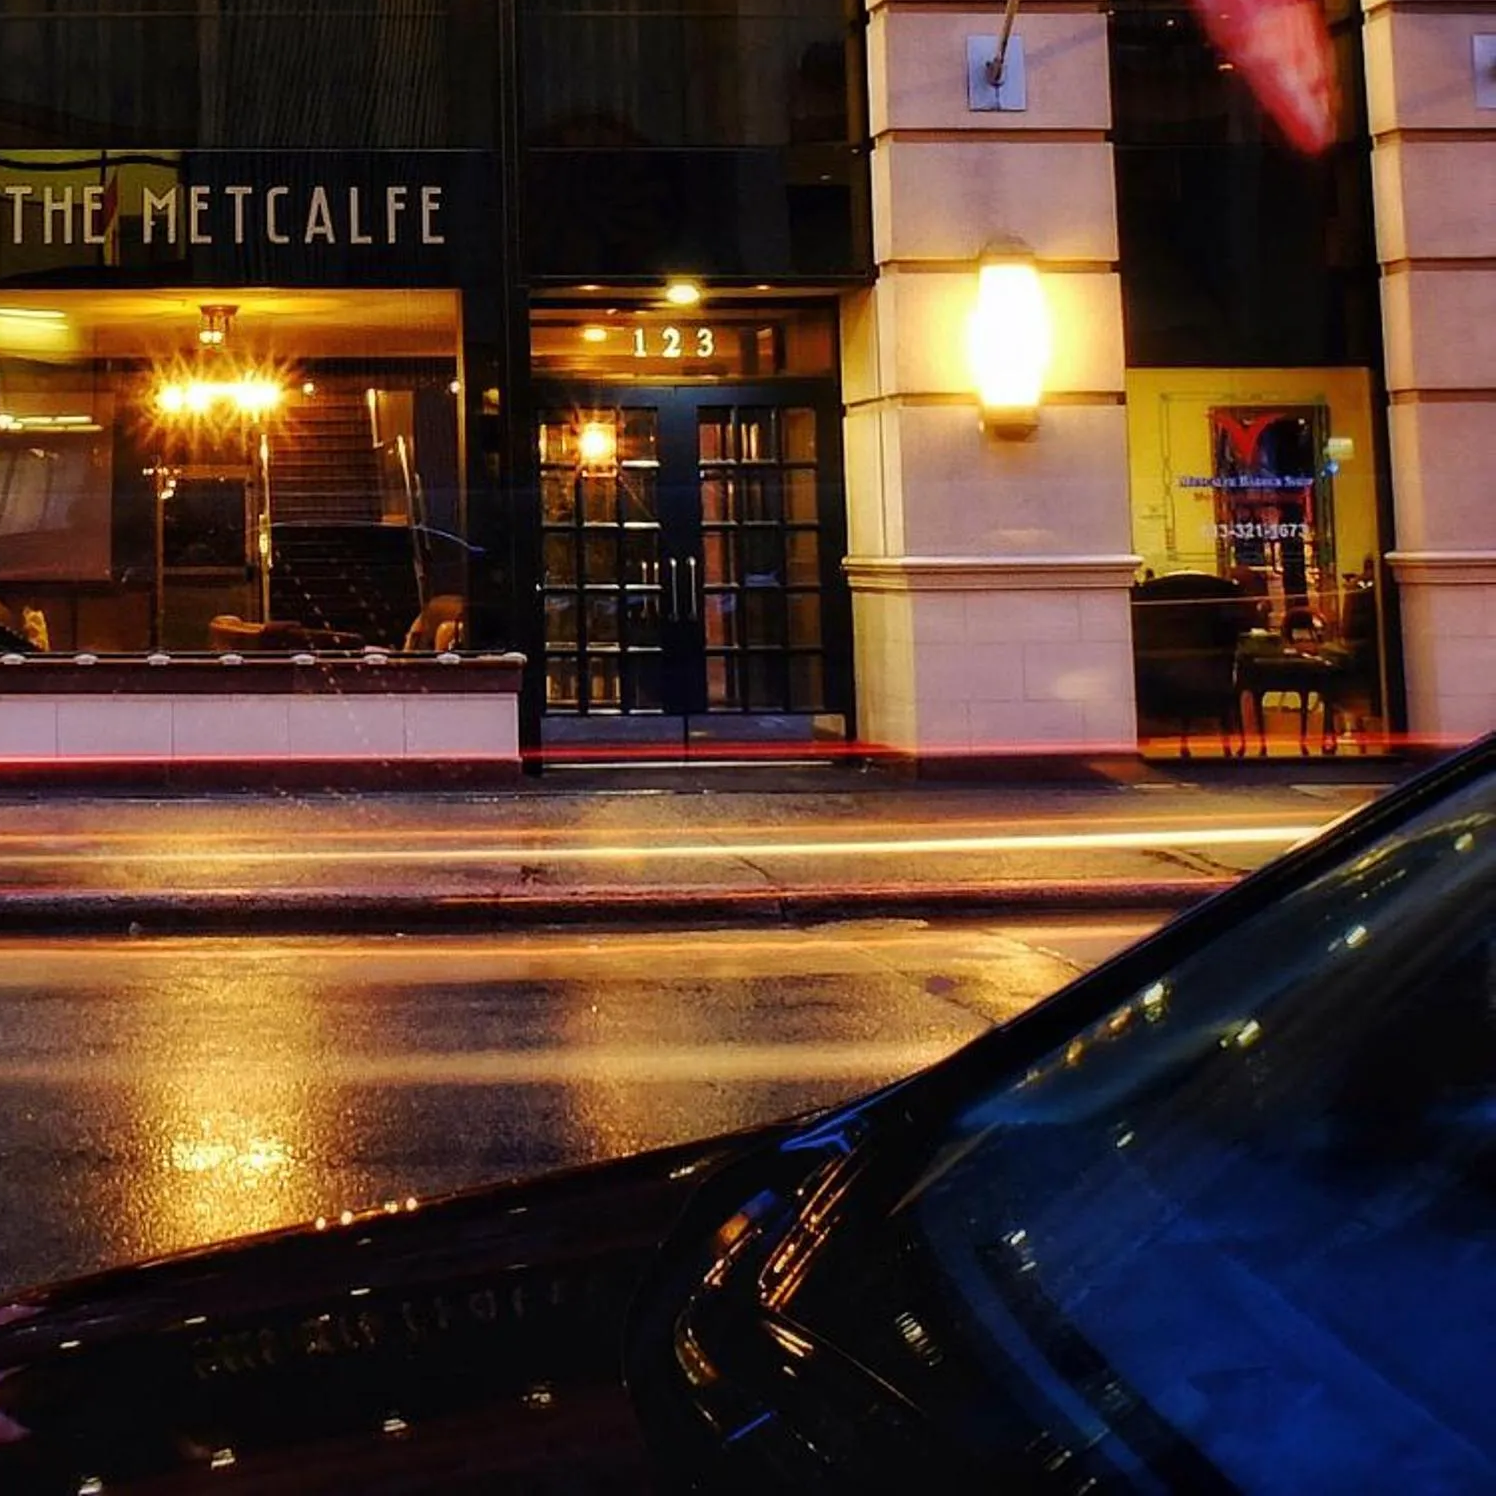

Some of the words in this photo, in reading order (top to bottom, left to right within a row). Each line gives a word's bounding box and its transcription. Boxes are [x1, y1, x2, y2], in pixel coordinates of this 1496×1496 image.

[5, 185, 104, 245] THE
[142, 185, 446, 245] METCALFE
[632, 326, 715, 359] 123
